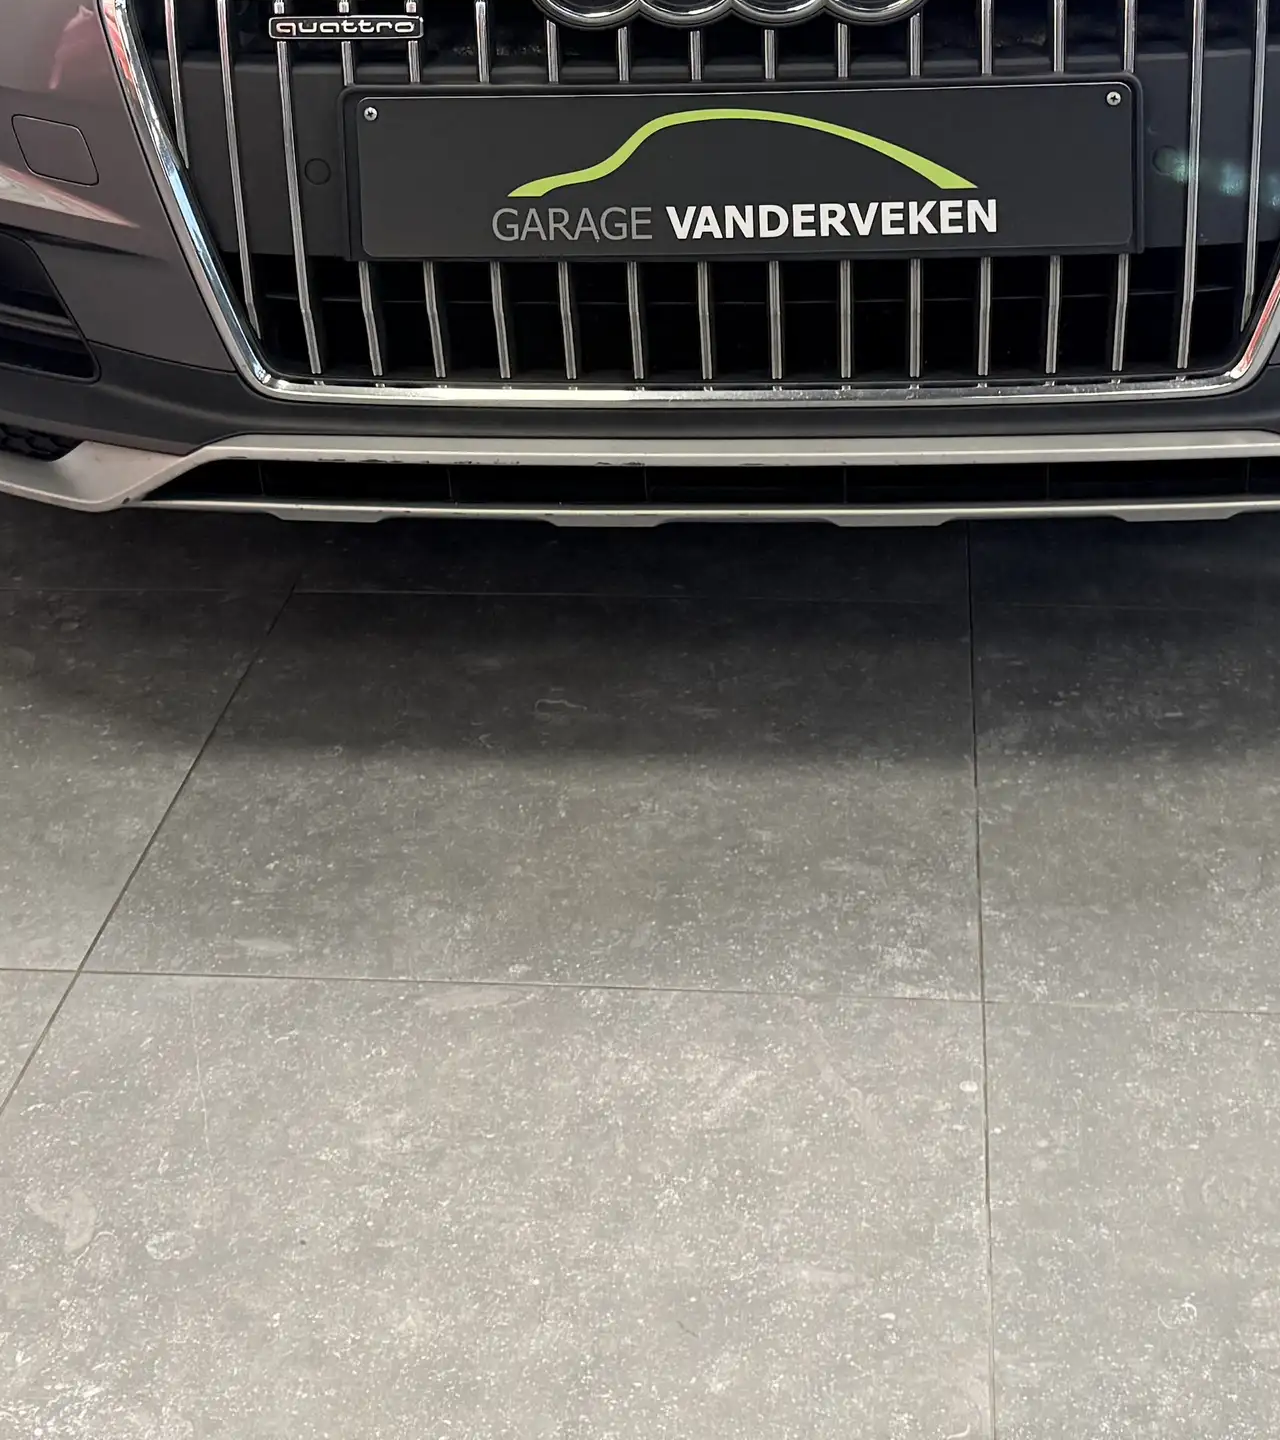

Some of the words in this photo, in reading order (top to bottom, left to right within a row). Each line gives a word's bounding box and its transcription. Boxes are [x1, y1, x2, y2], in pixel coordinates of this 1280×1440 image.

[275, 19, 415, 36] quattro
[491, 206, 653, 241] GARAGE
[665, 198, 998, 240] VANDERVEKEN
